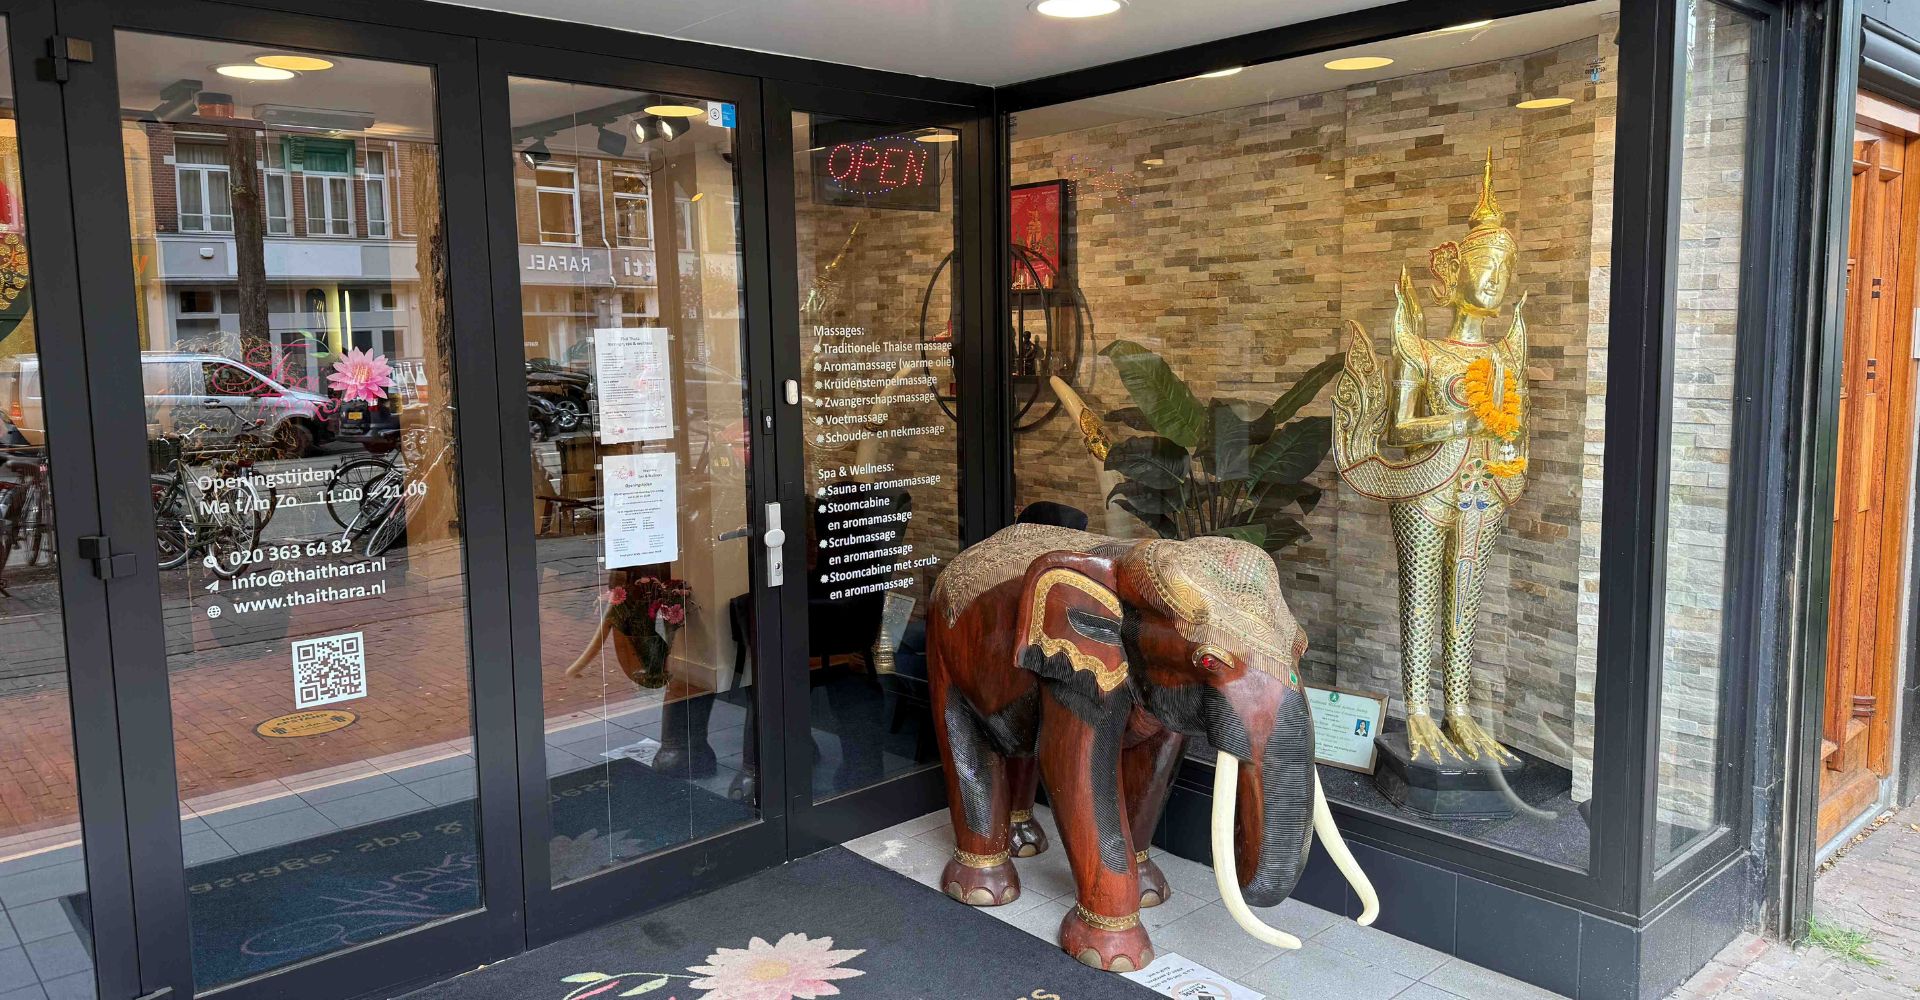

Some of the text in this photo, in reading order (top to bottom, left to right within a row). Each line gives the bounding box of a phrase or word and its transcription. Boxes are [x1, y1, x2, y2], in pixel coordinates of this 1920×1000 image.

[828, 144, 928, 186] OPEN
[813, 325, 865, 337] Massages:
[823, 340, 953, 354] Traditionele Thaise massage
[823, 356, 955, 372] Aromamassage (warme olie)
[825, 392, 935, 408] Zwangerschapsmassage
[825, 412, 889, 425] Voetmassage
[825, 424, 945, 443] Schouder- en nekmassage
[198, 467, 341, 493] Openingstijden:
[818, 463, 895, 480] Spa & Wellness:
[827, 474, 941, 496] Sauna en aromamassage
[200, 499, 230, 515] Ma
[235, 496, 270, 513] t/m
[275, 494, 298, 508] Zo
[316, 488, 363, 504] 11:00
[383, 482, 428, 499] 21.00
[827, 497, 890, 513] Stoomcabine
[828, 511, 912, 530] en aromamassage
[829, 530, 896, 548] Scrubmassage
[229, 539, 353, 566] 020 363 64 82
[829, 544, 913, 566] en aromamassage
[231, 557, 387, 590] info@thaithara.nl
[829, 554, 940, 583] Stoomcabine met scrub-
[233, 580, 387, 614] www.thaithara.nl
[830, 576, 914, 600] en aromamassage
[1182, 984, 1207, 997] PLEASE
